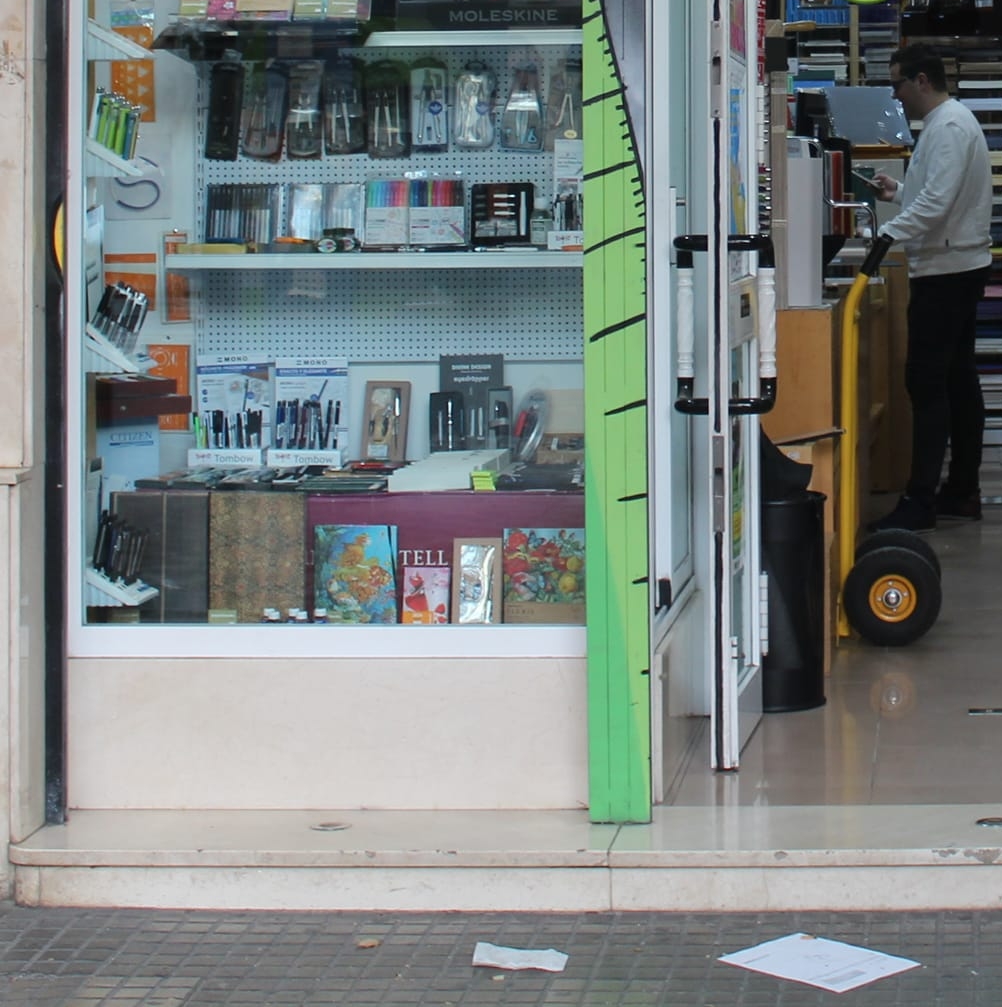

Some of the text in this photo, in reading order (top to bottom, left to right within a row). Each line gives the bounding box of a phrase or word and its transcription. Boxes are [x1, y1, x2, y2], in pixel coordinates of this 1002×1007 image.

[450, 9, 558, 22] MOLESKINE
[224, 355, 249, 363] MONO
[110, 431, 153, 442] CITIZEN
[214, 454, 254, 463] Tombow
[295, 455, 333, 464] Tombow
